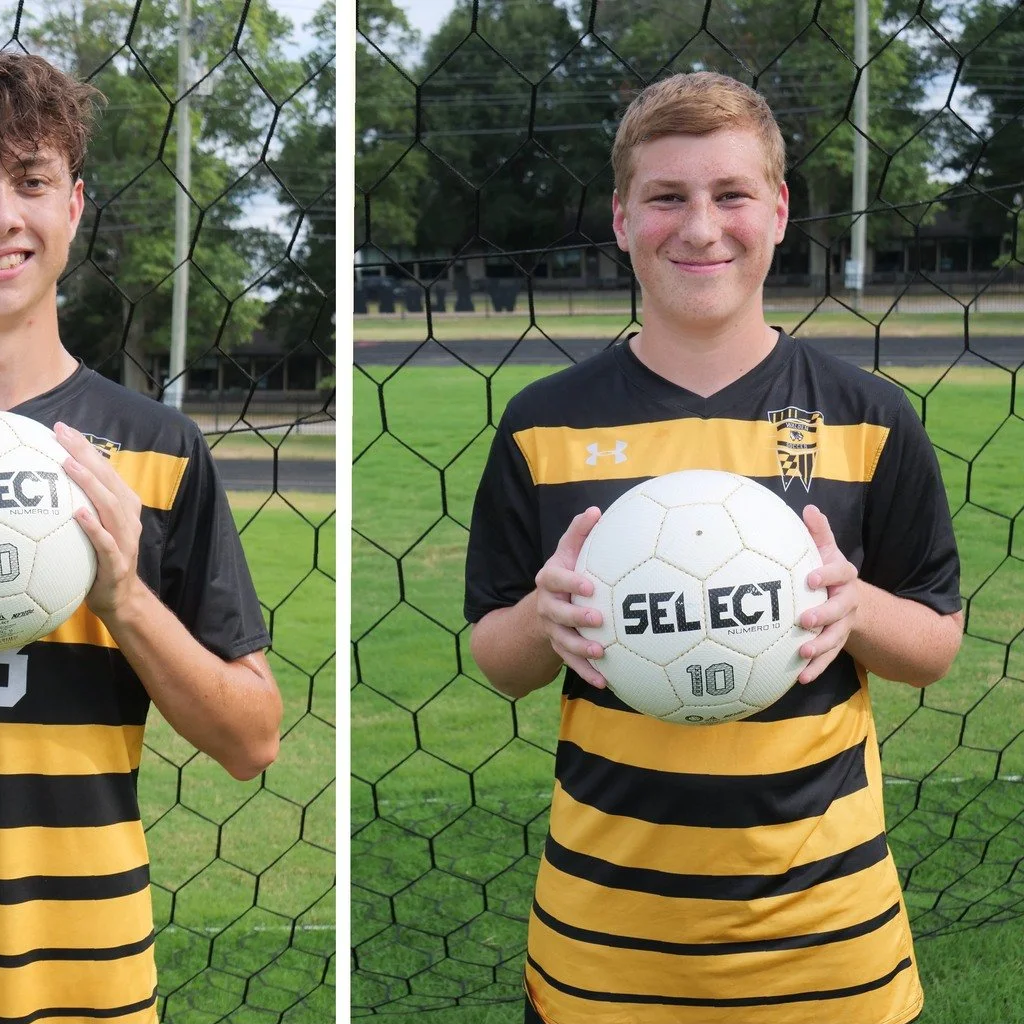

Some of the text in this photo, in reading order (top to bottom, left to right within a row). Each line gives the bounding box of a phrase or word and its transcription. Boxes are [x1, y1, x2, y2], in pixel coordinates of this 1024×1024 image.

[786, 422, 809, 431] WALDEN
[10, 508, 50, 516] NUMERO
[622, 580, 782, 635] SELECT
[727, 624, 770, 636] NUMERO
[686, 661, 735, 698] 10
